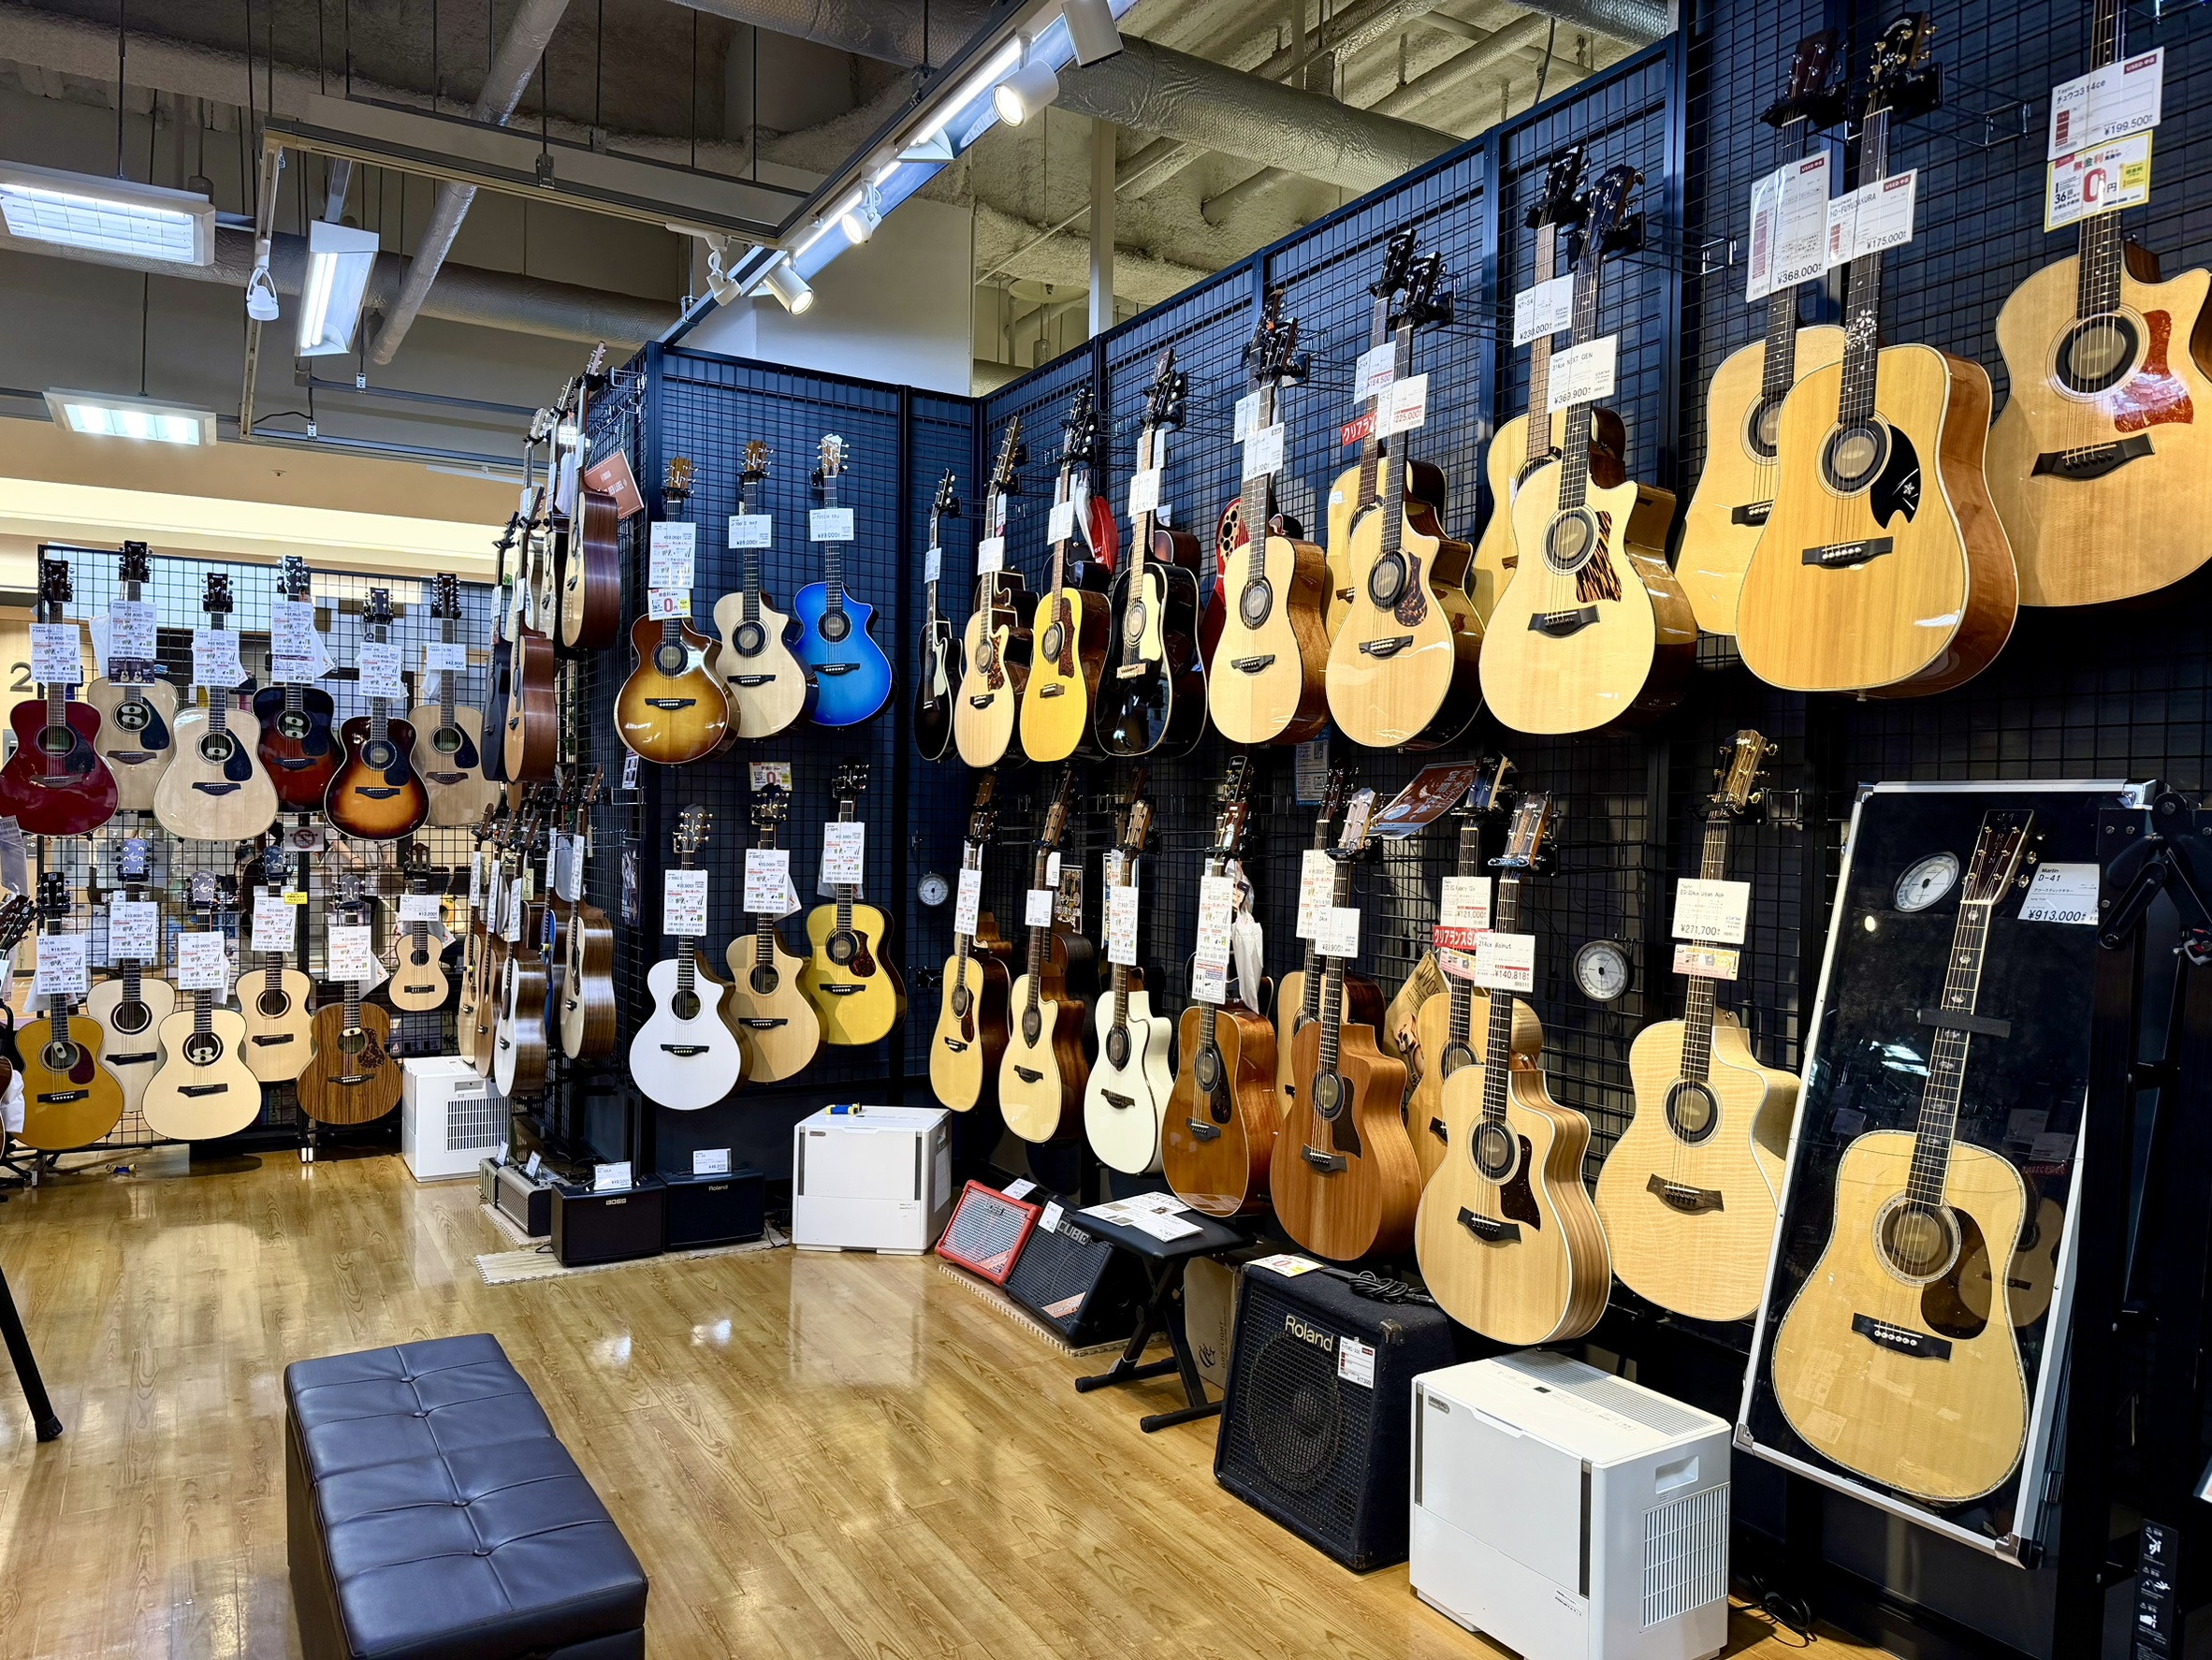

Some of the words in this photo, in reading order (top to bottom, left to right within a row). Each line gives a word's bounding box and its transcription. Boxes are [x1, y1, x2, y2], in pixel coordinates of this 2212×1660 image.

[9, 662, 33, 692] 2
[2028, 910, 2081, 922] ¥913,000
[605, 1198, 627, 1206] BOSS
[1056, 1219, 1090, 1245] CUBE
[1286, 1315, 1334, 1352] Roland
